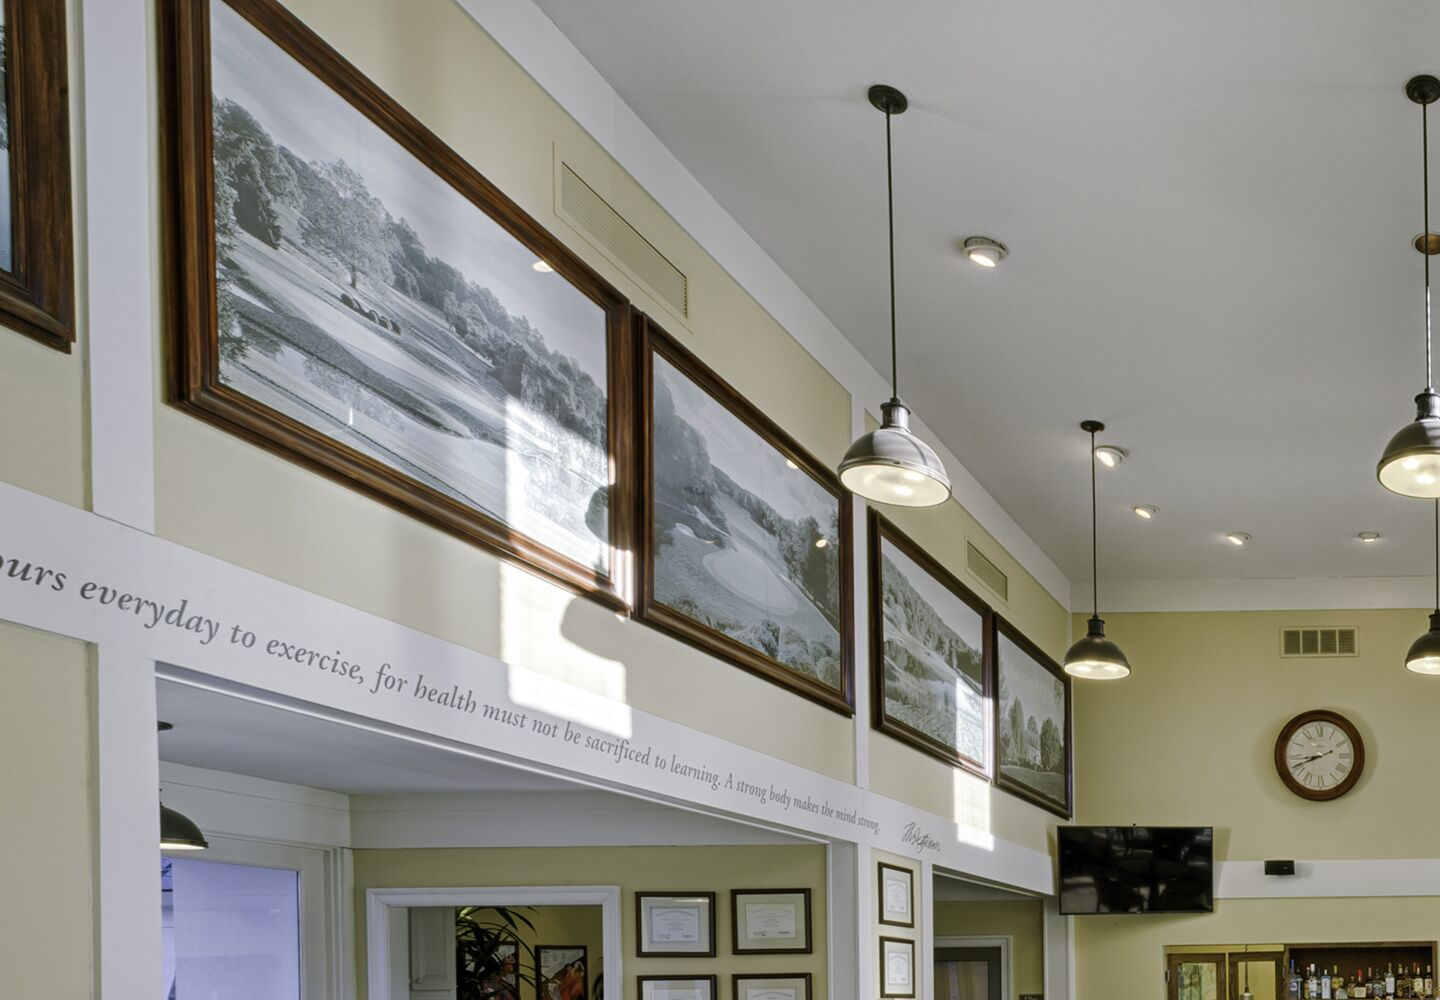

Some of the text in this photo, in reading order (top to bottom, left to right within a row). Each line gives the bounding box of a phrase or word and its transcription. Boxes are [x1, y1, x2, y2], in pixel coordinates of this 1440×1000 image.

[0, 555, 67, 591] urs
[80, 581, 220, 645] everyday
[230, 625, 256, 648] to
[266, 638, 364, 684] exercise,
[370, 663, 408, 694] for
[413, 674, 477, 714] health
[482, 703, 527, 729] must
[532, 718, 559, 739] not
[563, 721, 581, 745] be
[585, 734, 651, 765] sacrificed
[654, 754, 667, 771] to
[670, 754, 721, 791] learning.
[724, 773, 734, 789] A
[736, 778, 767, 804] strong
[769, 784, 791, 810] body
[793, 795, 820, 814] makes
[821, 802, 834, 818] the
[835, 808, 857, 824] mind
